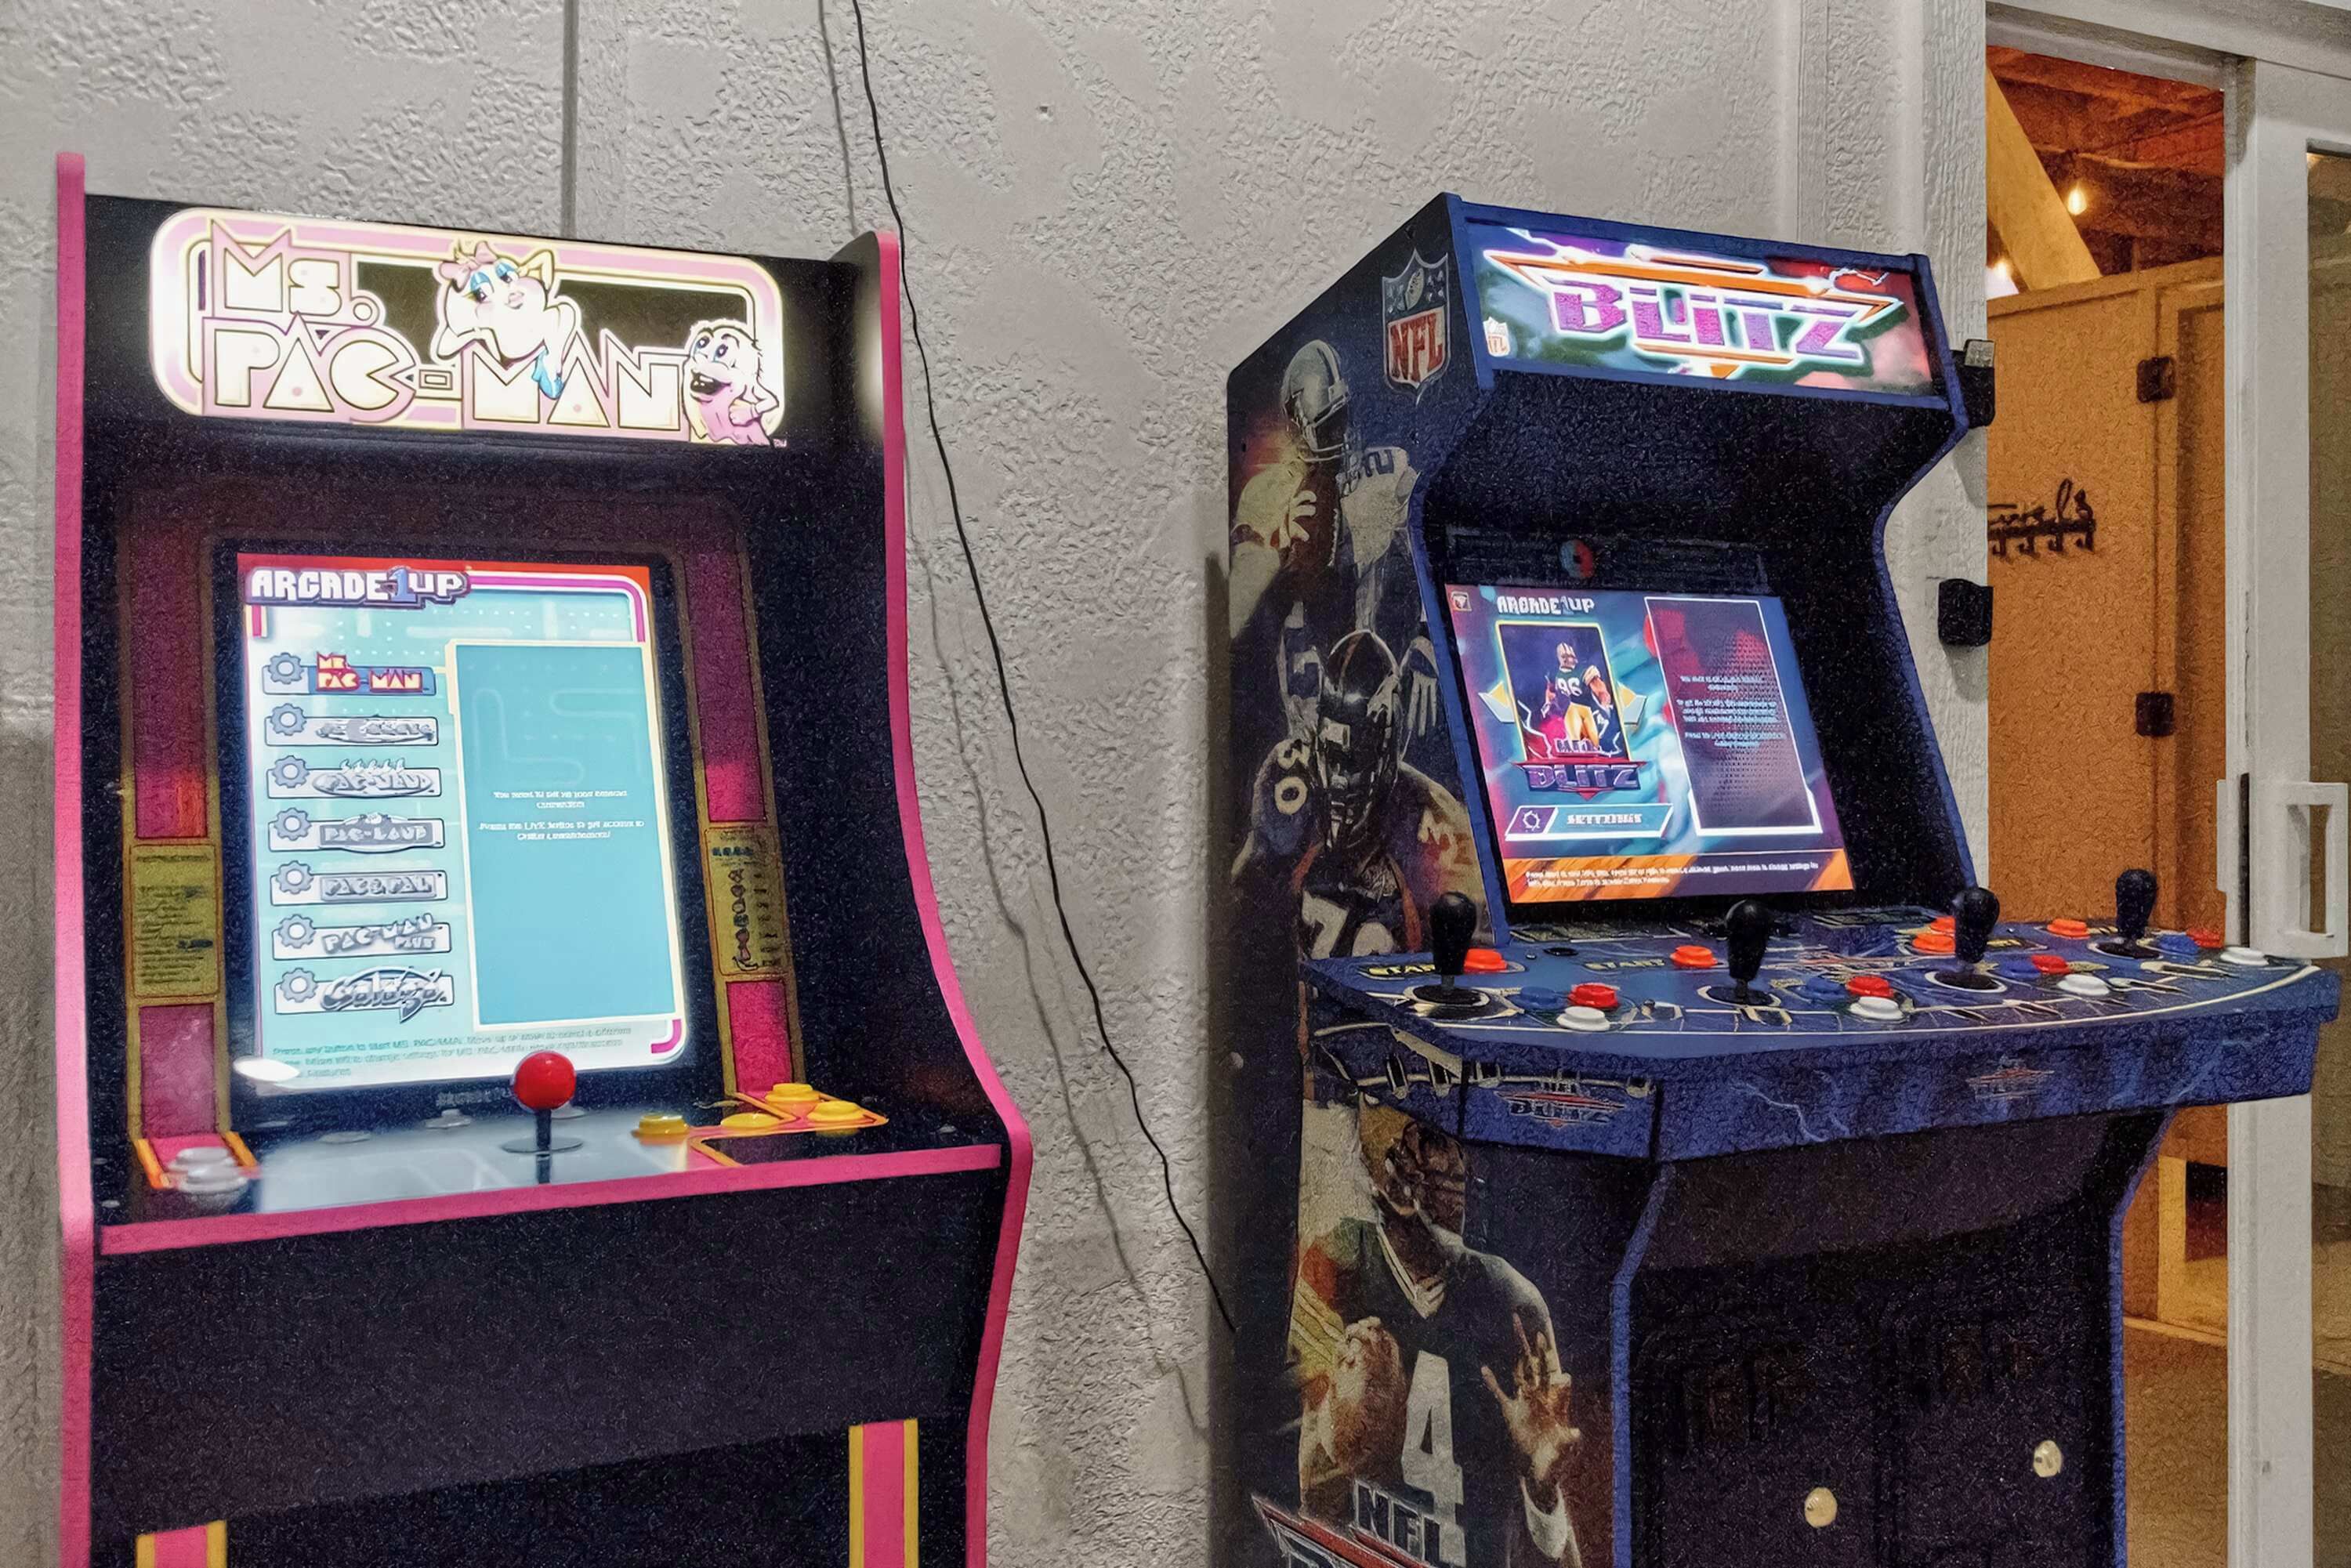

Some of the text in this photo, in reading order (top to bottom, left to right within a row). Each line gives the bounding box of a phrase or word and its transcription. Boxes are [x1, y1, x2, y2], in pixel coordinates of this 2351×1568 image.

[220, 229, 378, 321] Ms.
[1545, 274, 1862, 360] BLITZ
[212, 323, 683, 431] PAC-MAN
[1390, 313, 1443, 382] NFL
[317, 670, 422, 691] PAC-MAN
